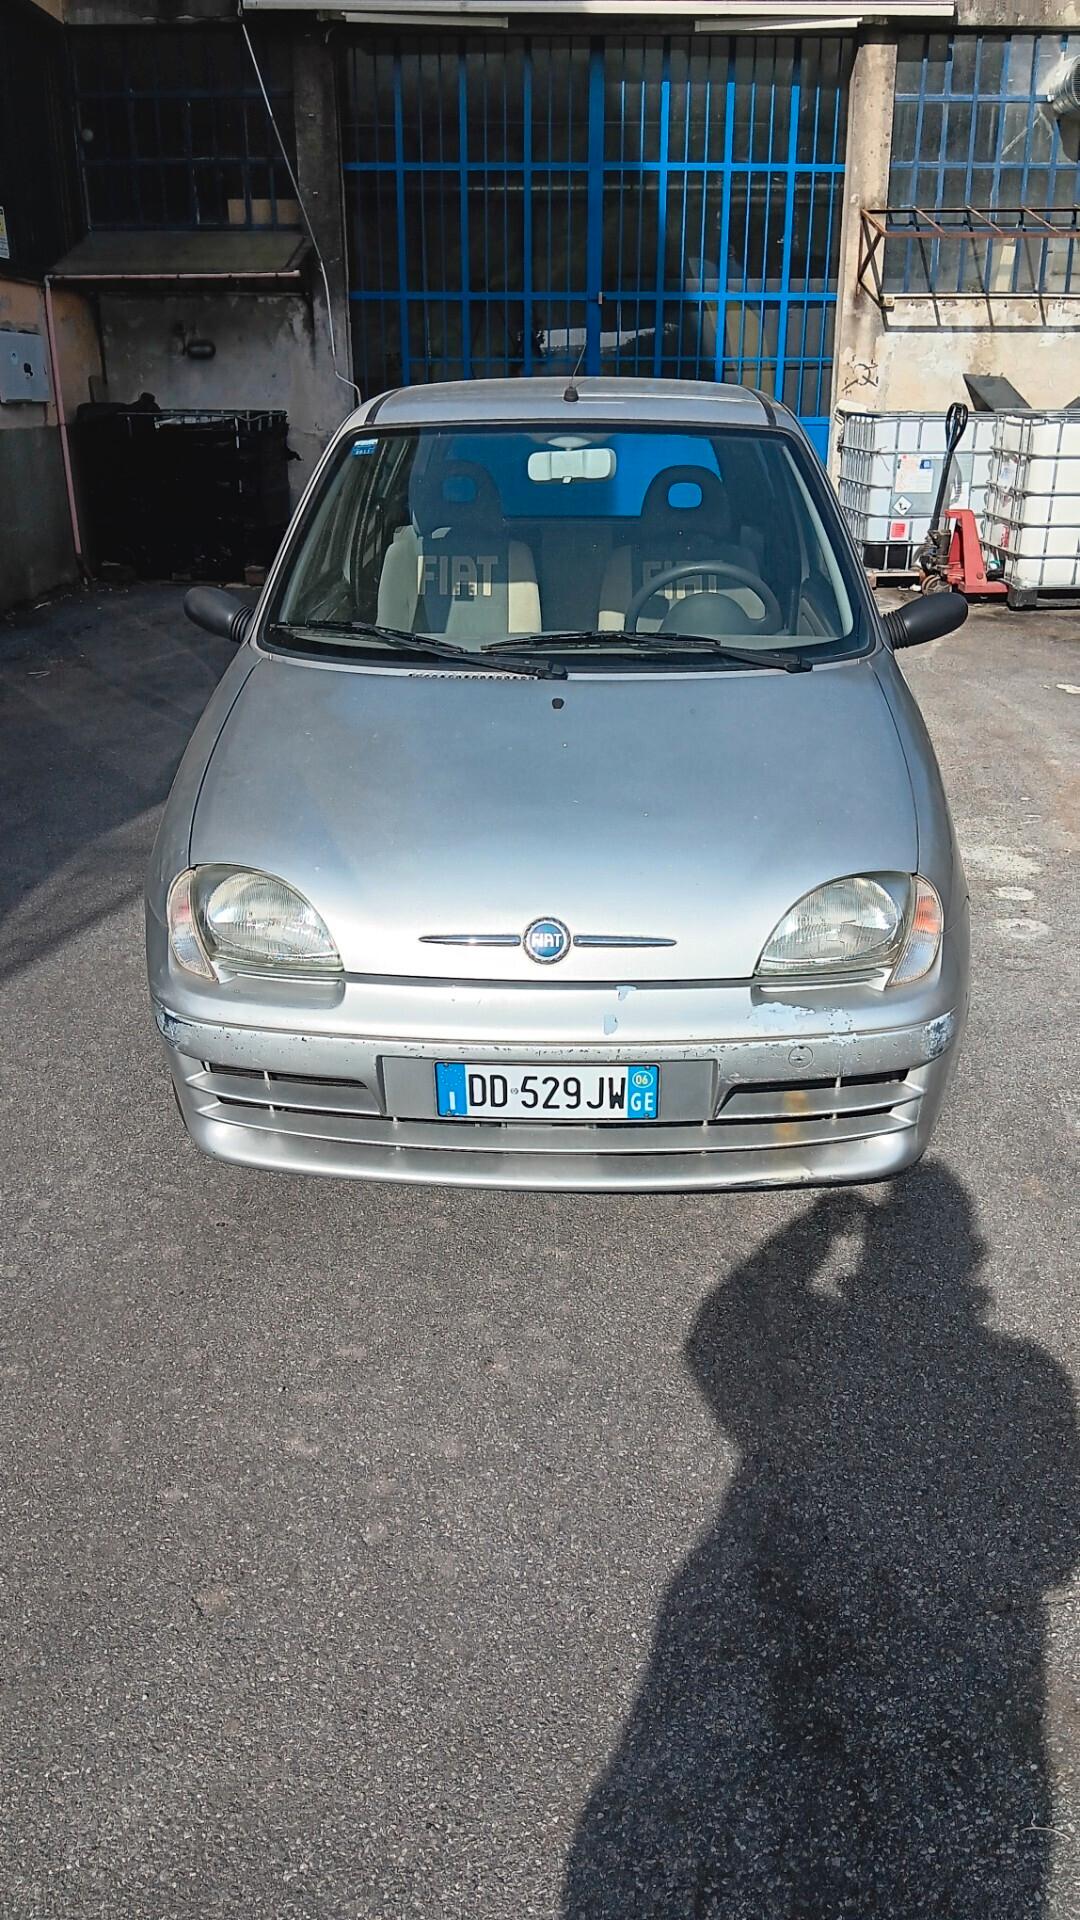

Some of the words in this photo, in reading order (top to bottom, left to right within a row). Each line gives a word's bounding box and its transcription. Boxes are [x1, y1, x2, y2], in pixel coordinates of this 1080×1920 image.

[417, 555, 498, 596] FIAT
[531, 932, 562, 948] FIAT
[635, 1074, 648, 1085] 06
[468, 1074, 508, 1107] DD
[631, 1092, 654, 1111] GE
